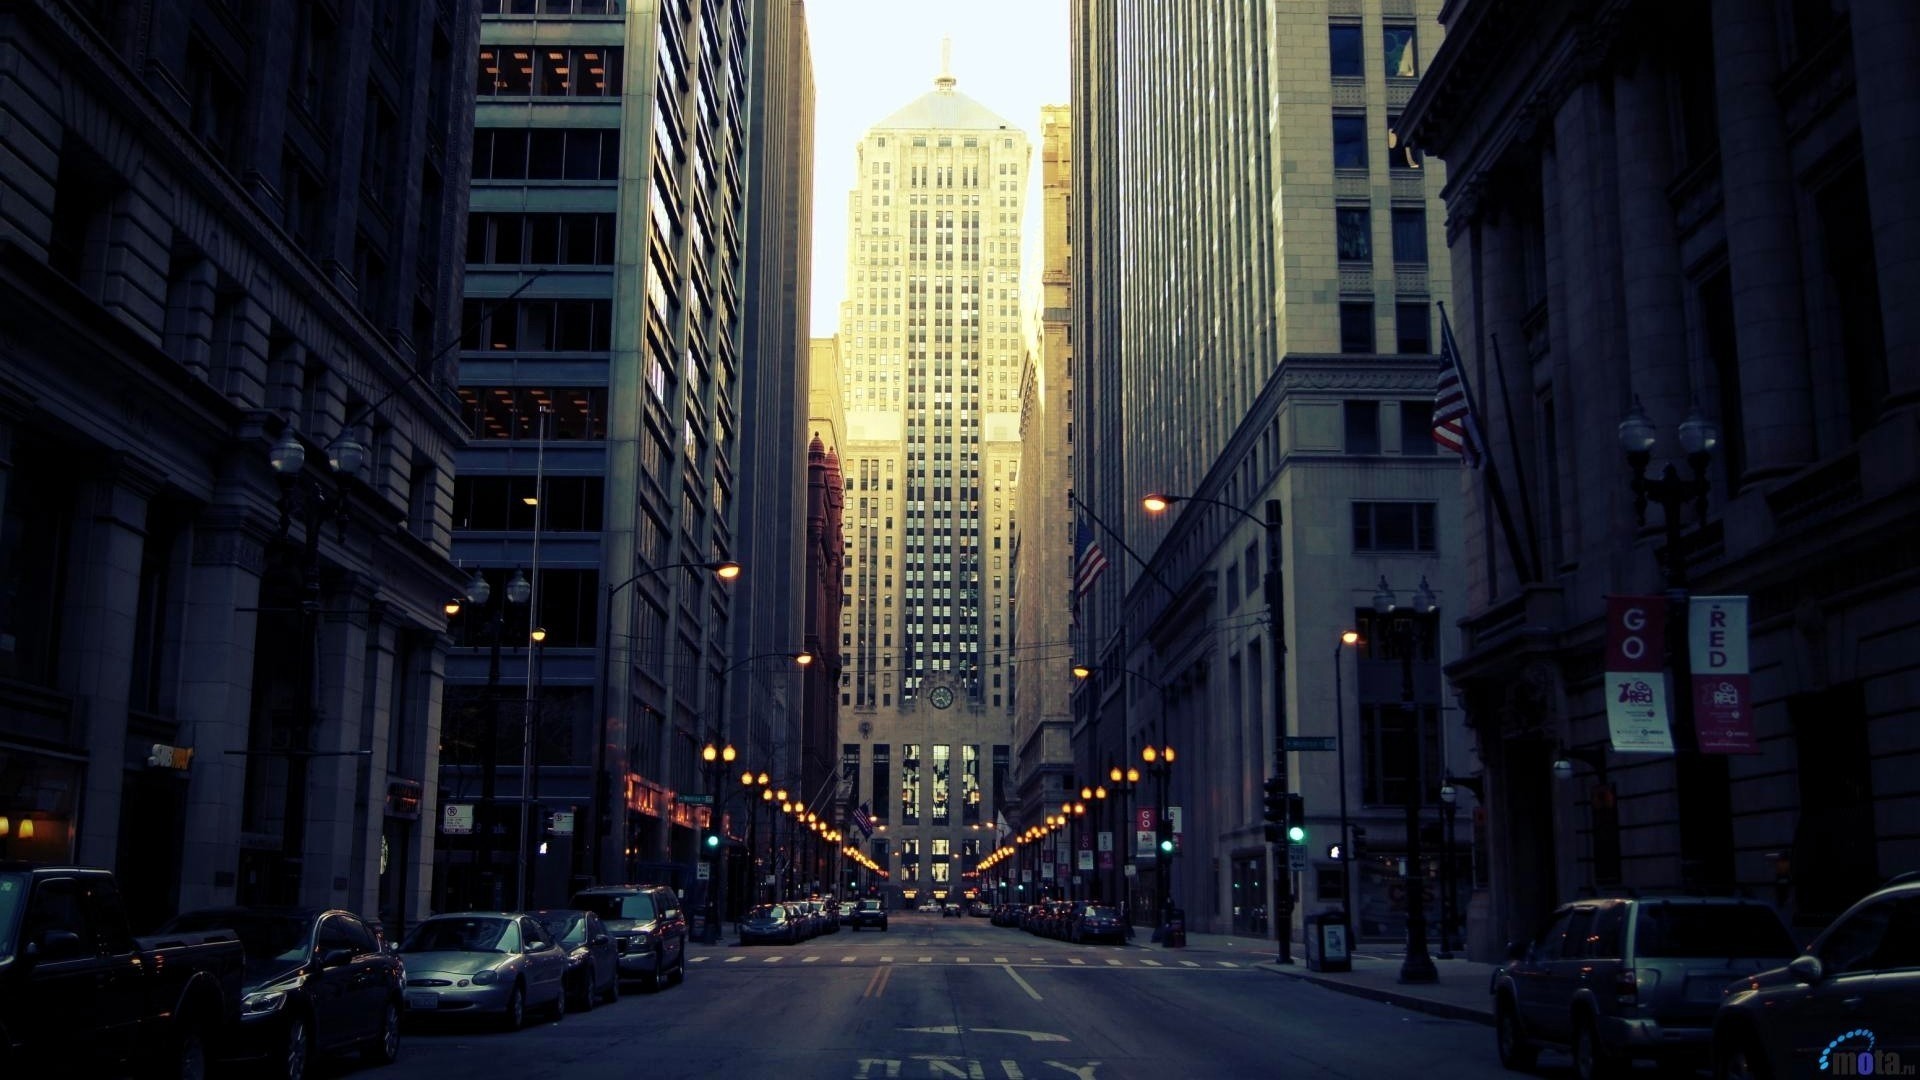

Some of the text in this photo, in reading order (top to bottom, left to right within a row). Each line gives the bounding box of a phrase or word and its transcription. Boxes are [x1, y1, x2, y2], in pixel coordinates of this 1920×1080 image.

[1622, 607, 1646, 660] GO
[1710, 610, 1727, 668] RED
[1142, 811, 1151, 828] GO
